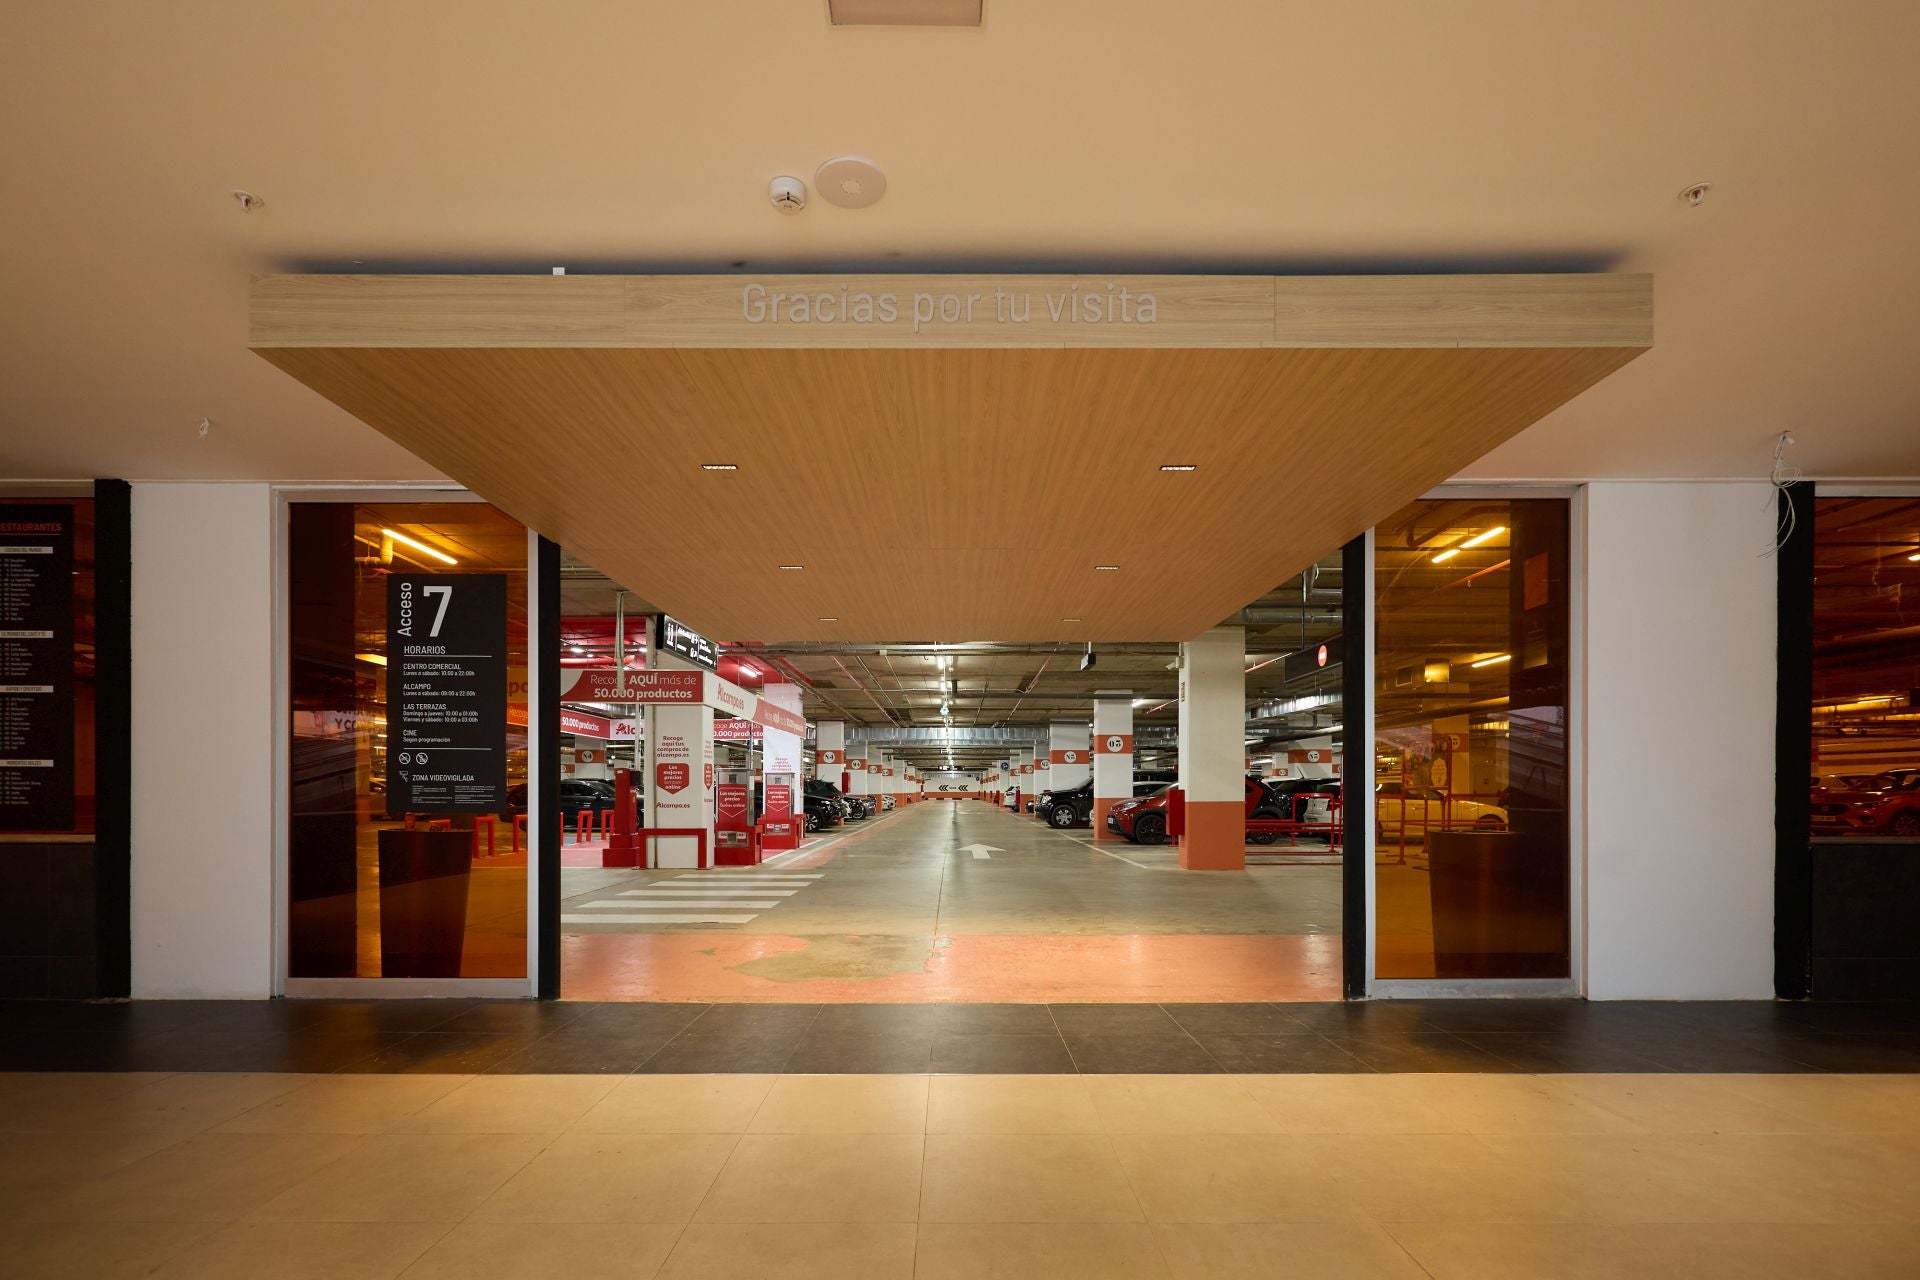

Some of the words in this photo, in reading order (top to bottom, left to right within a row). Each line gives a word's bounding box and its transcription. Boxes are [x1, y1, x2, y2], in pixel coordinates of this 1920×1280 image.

[742, 283, 898, 324] Gracias
[913, 291, 982, 334] por
[994, 289, 1030, 324] tu
[1046, 283, 1157, 324] visita
[397, 582, 412, 637] Acceso
[423, 585, 453, 637] 7
[403, 645, 446, 655] HORARIOS
[629, 672, 658, 686] AQUÍ
[660, 674, 681, 685] más
[684, 674, 697, 685] de
[636, 688, 692, 700] productos
[729, 722, 746, 730] AQUÍ
